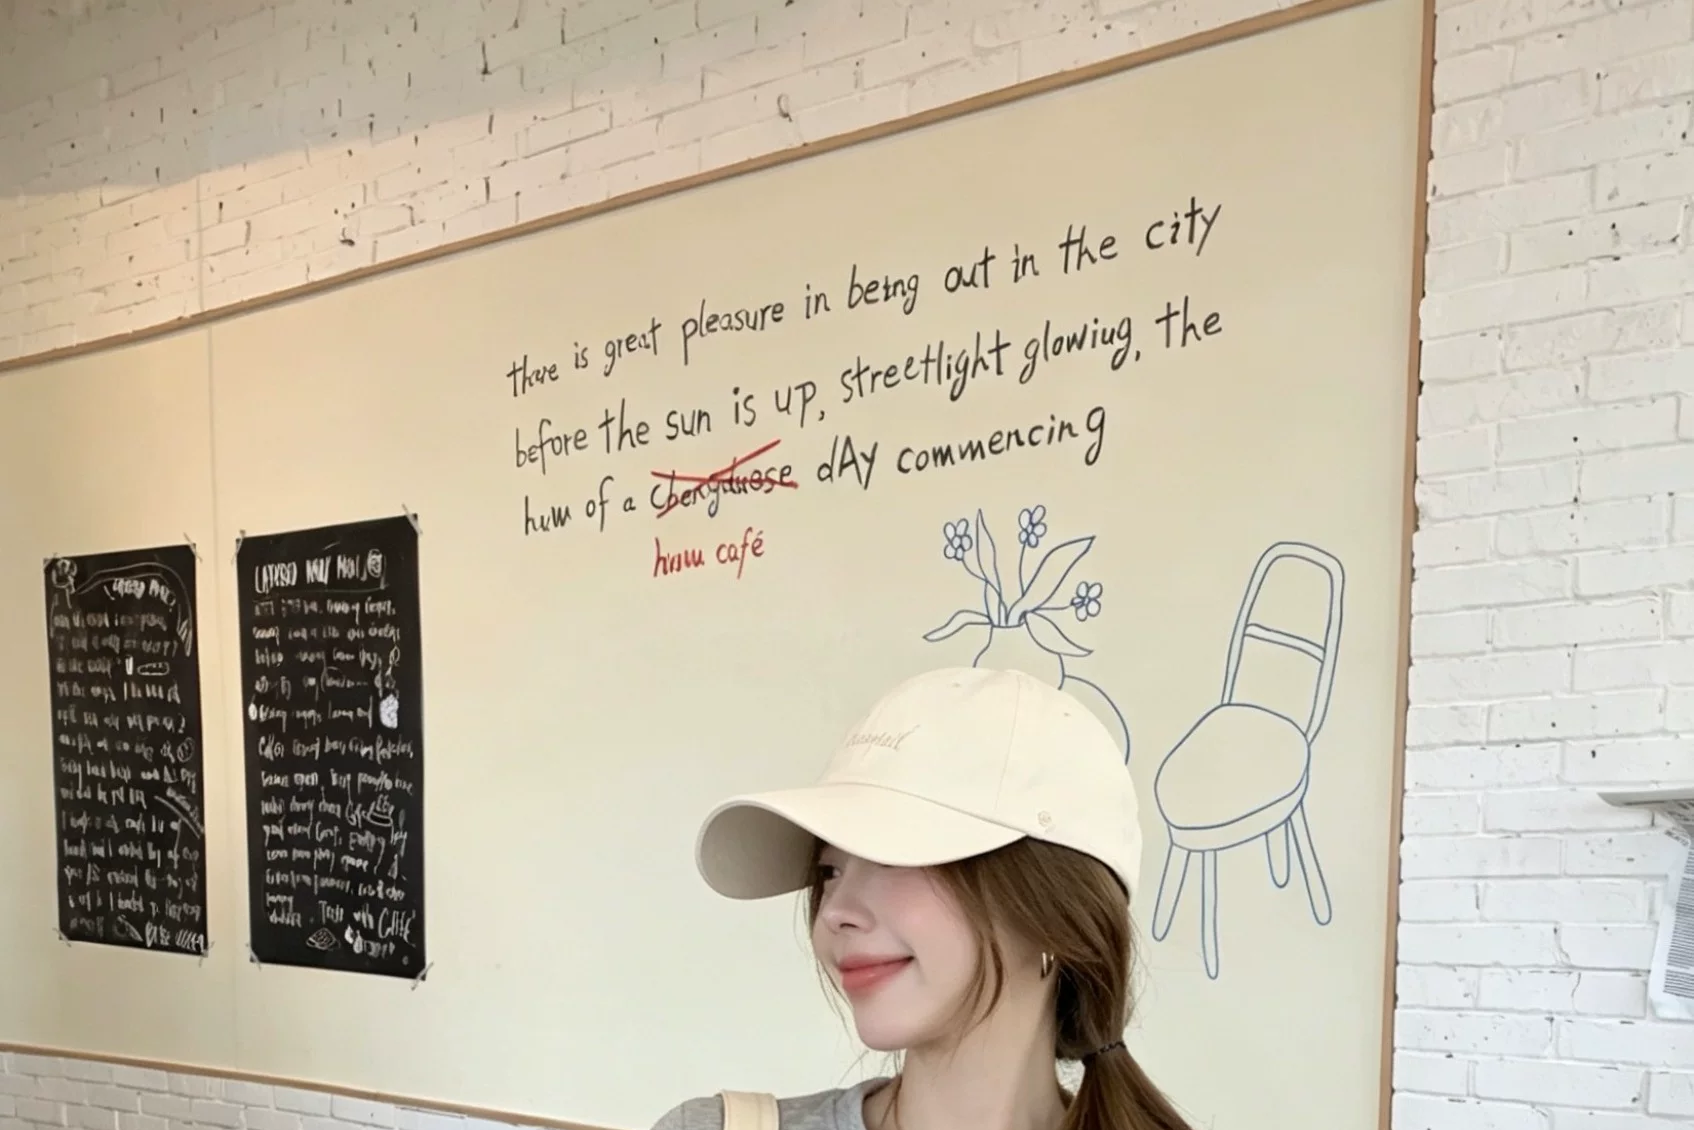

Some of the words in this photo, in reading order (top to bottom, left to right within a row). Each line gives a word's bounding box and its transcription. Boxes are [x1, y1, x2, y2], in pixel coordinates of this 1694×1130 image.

[573, 341, 589, 369] is
[602, 316, 663, 377] great
[681, 298, 785, 366] pleasure
[804, 284, 832, 319] in
[847, 264, 920, 315] being
[944, 246, 997, 293] out
[1012, 243, 1040, 283] in
[1058, 223, 1119, 274] the
[1144, 196, 1222, 256] city
[515, 417, 589, 475] before
[597, 397, 651, 454] the
[665, 408, 712, 441] sun
[731, 386, 757, 427] is
[839, 329, 1012, 403] streetlight
[1154, 294, 1223, 348] the
[585, 474, 615, 532] of
[622, 495, 637, 513] a
[896, 405, 1106, 475] commencing
[715, 525, 765, 580] café
